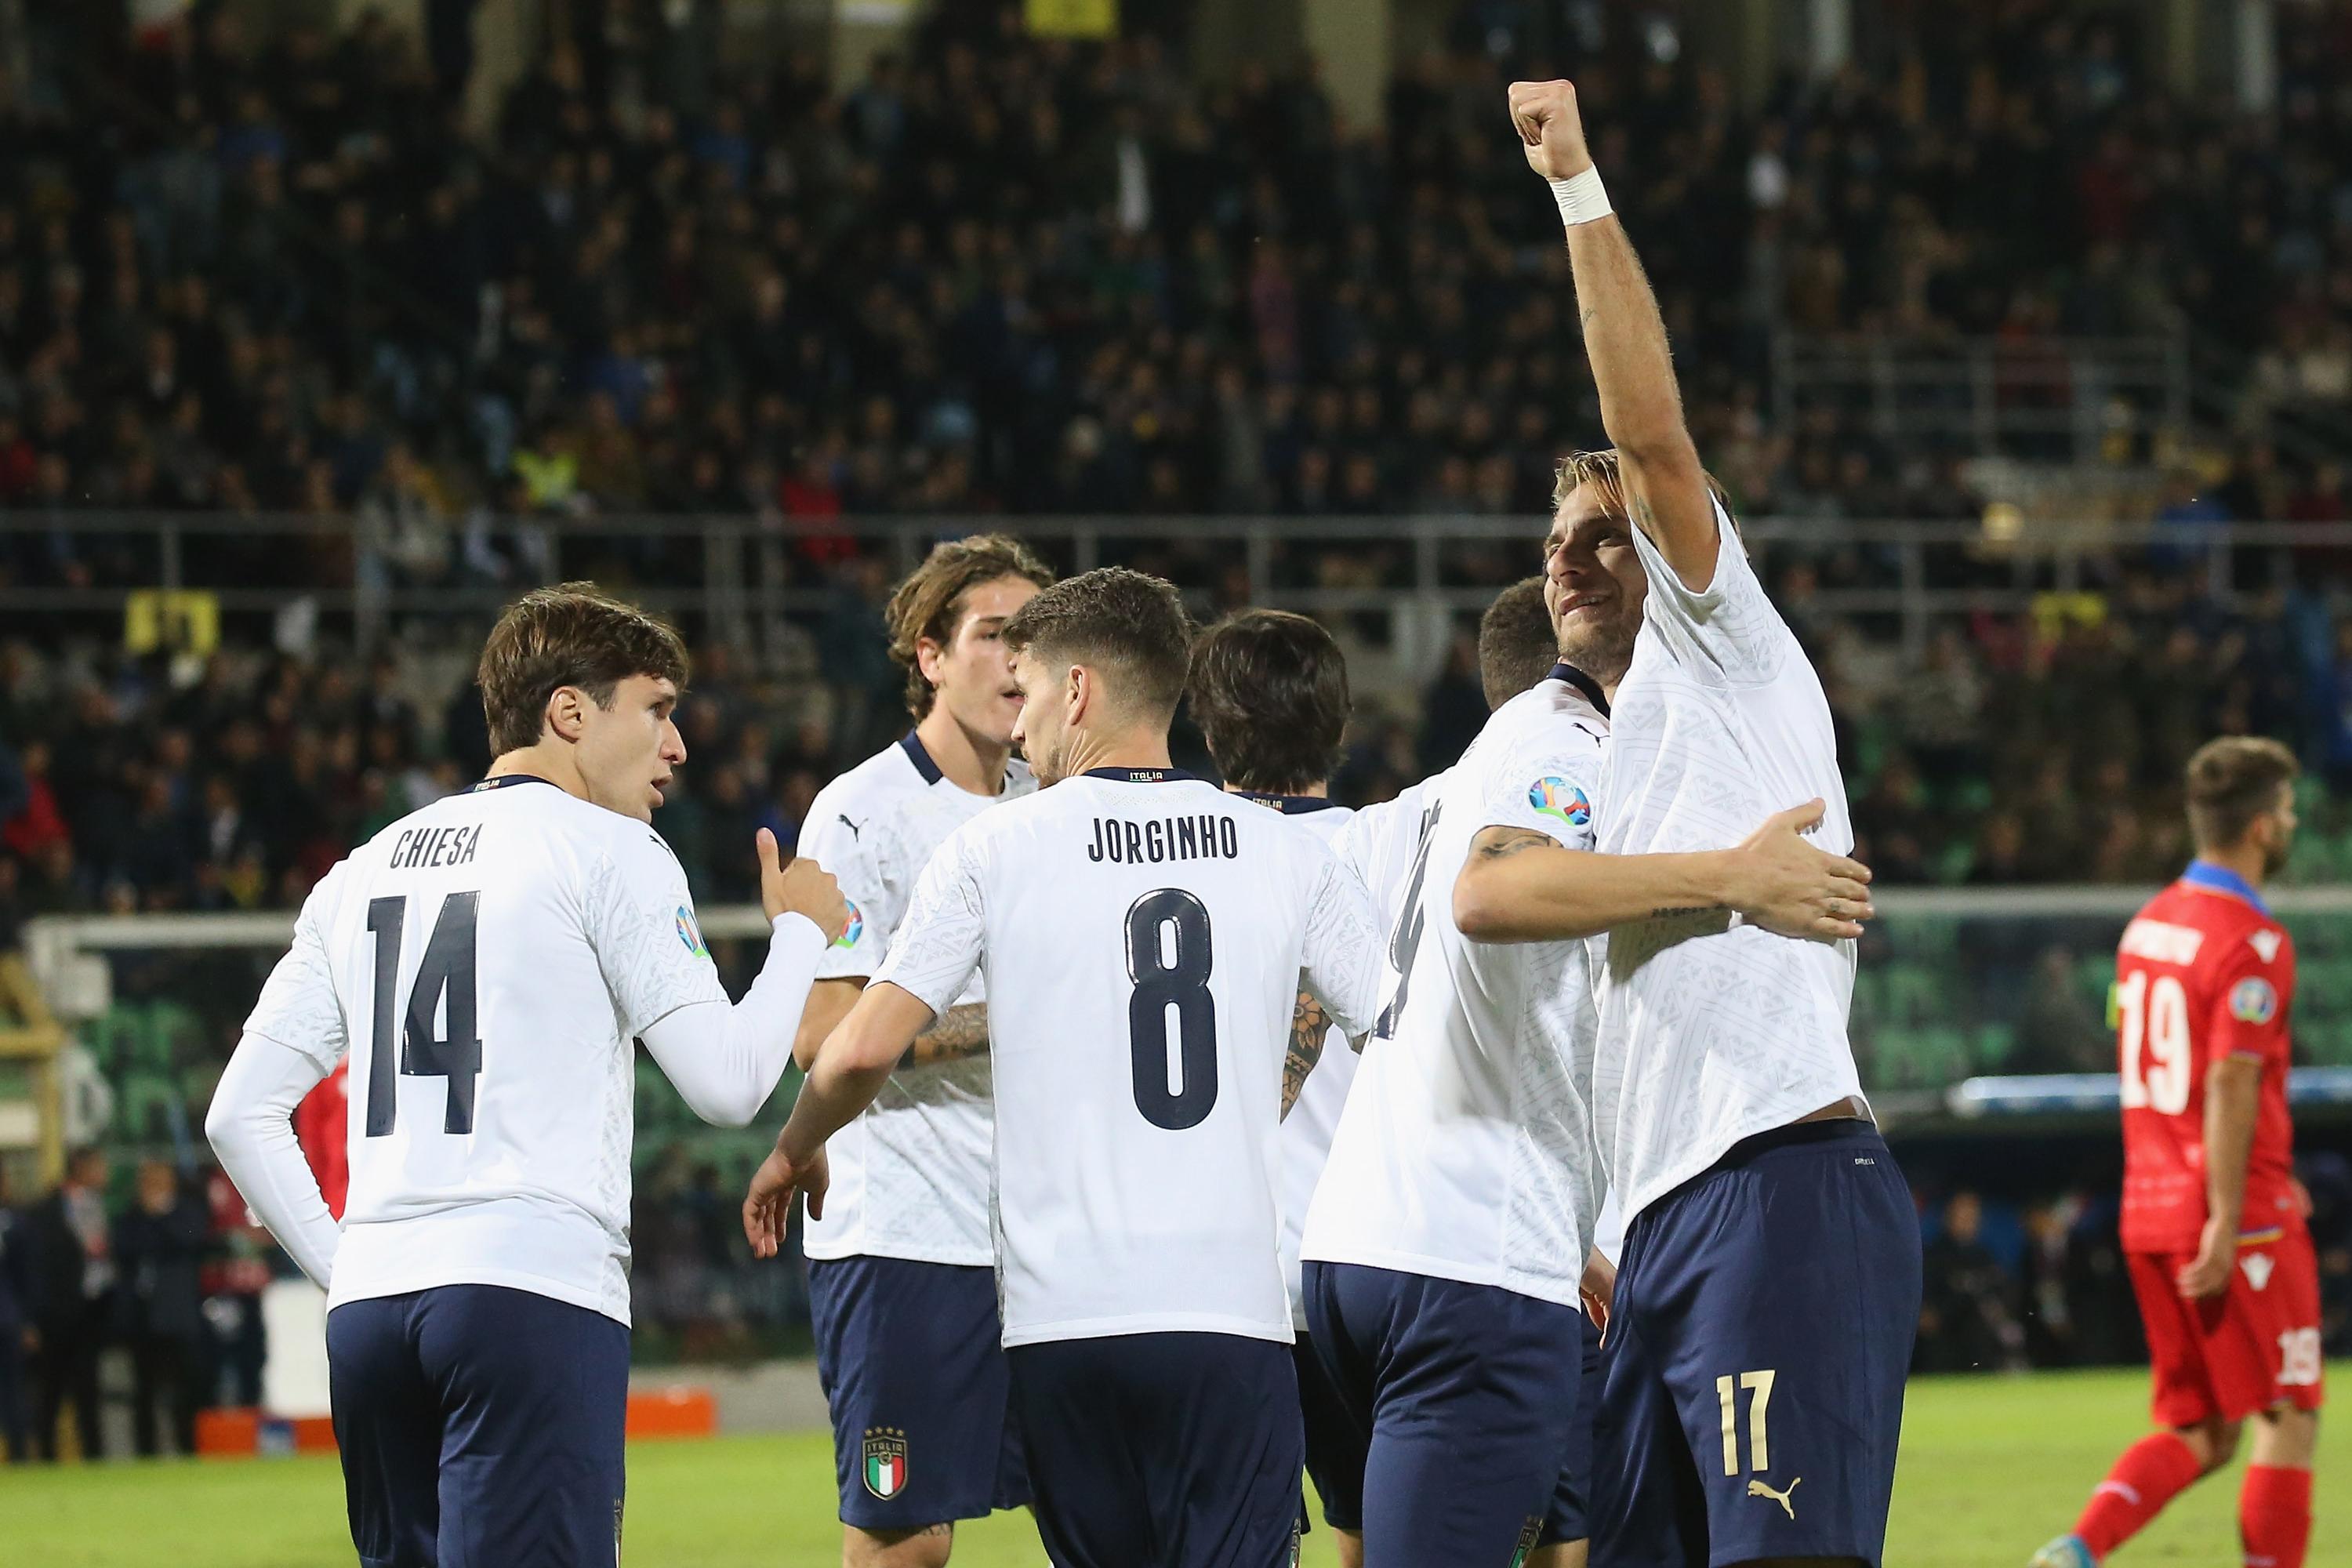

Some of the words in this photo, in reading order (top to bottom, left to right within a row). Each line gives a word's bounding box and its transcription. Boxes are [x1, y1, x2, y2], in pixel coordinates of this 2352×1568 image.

[390, 822, 483, 869] CHIESA
[1087, 815, 1238, 864] JORGINHO
[365, 891, 482, 1138] 14
[1123, 887, 1218, 1131] 8
[2117, 969, 2192, 1116] 19
[867, 1443, 903, 1453] ITALIA
[1716, 1369, 1776, 1477] 17
